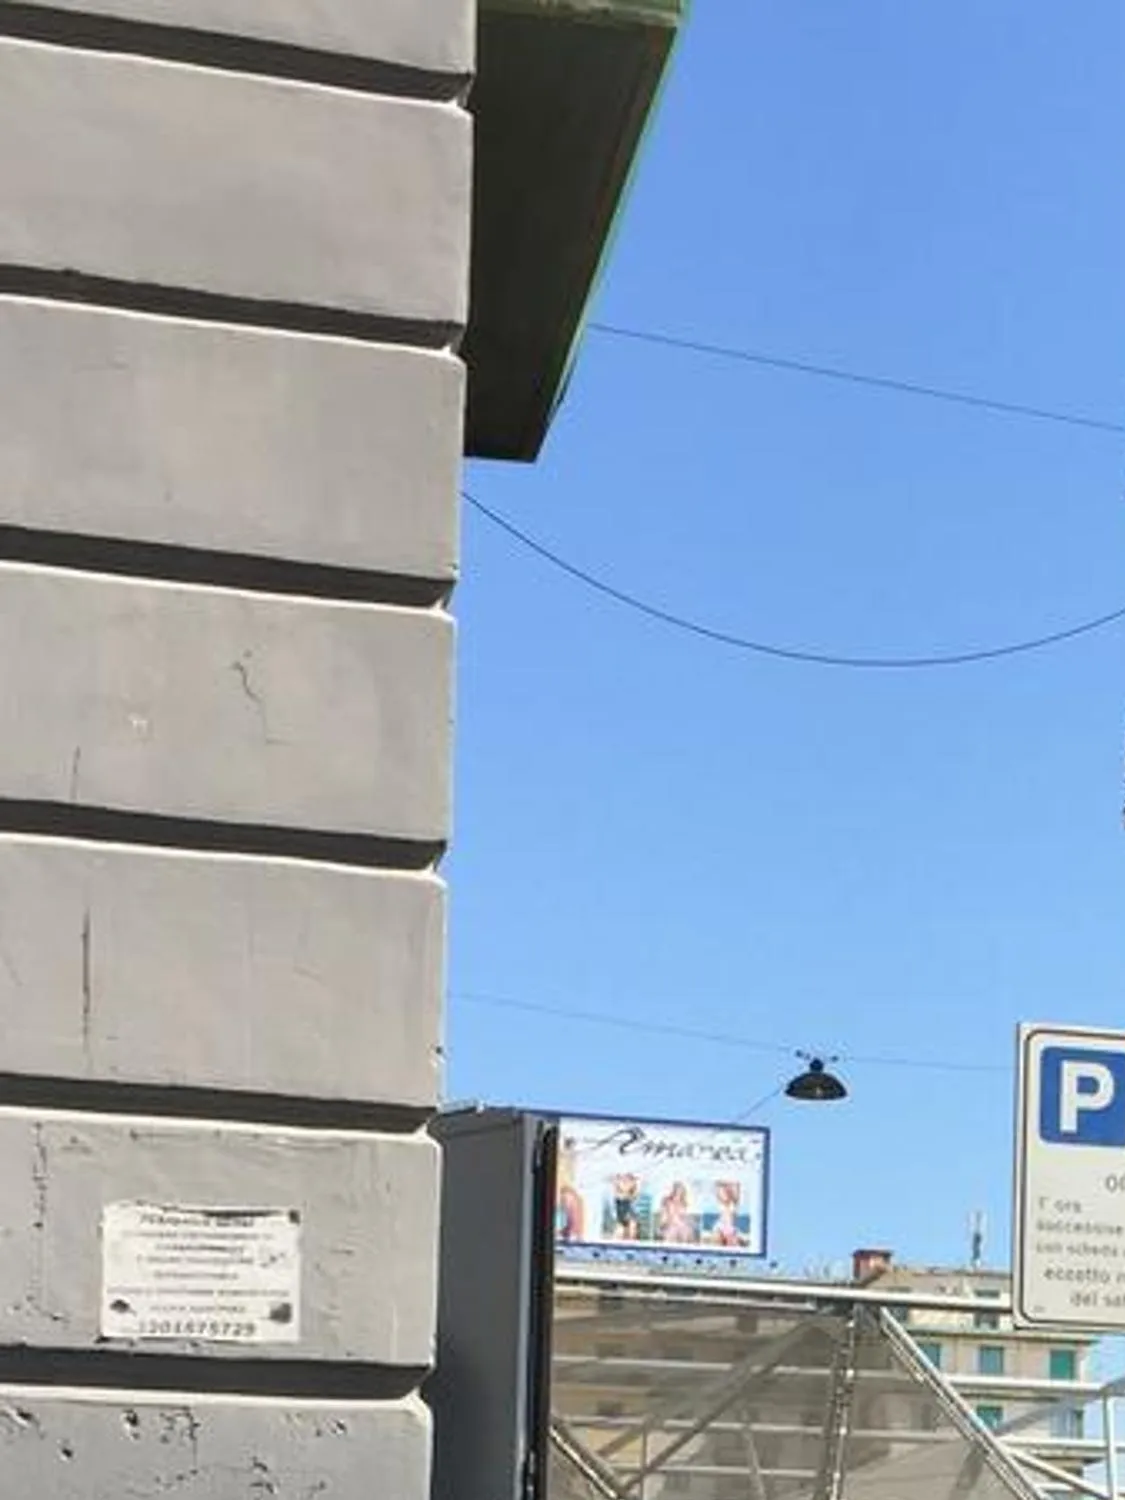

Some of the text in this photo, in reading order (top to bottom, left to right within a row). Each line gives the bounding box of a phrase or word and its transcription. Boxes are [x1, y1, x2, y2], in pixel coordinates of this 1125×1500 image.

[1059, 1060, 1115, 1134] P
[1043, 1267, 1111, 1284] eccetto
[1069, 1289, 1098, 1307] del
